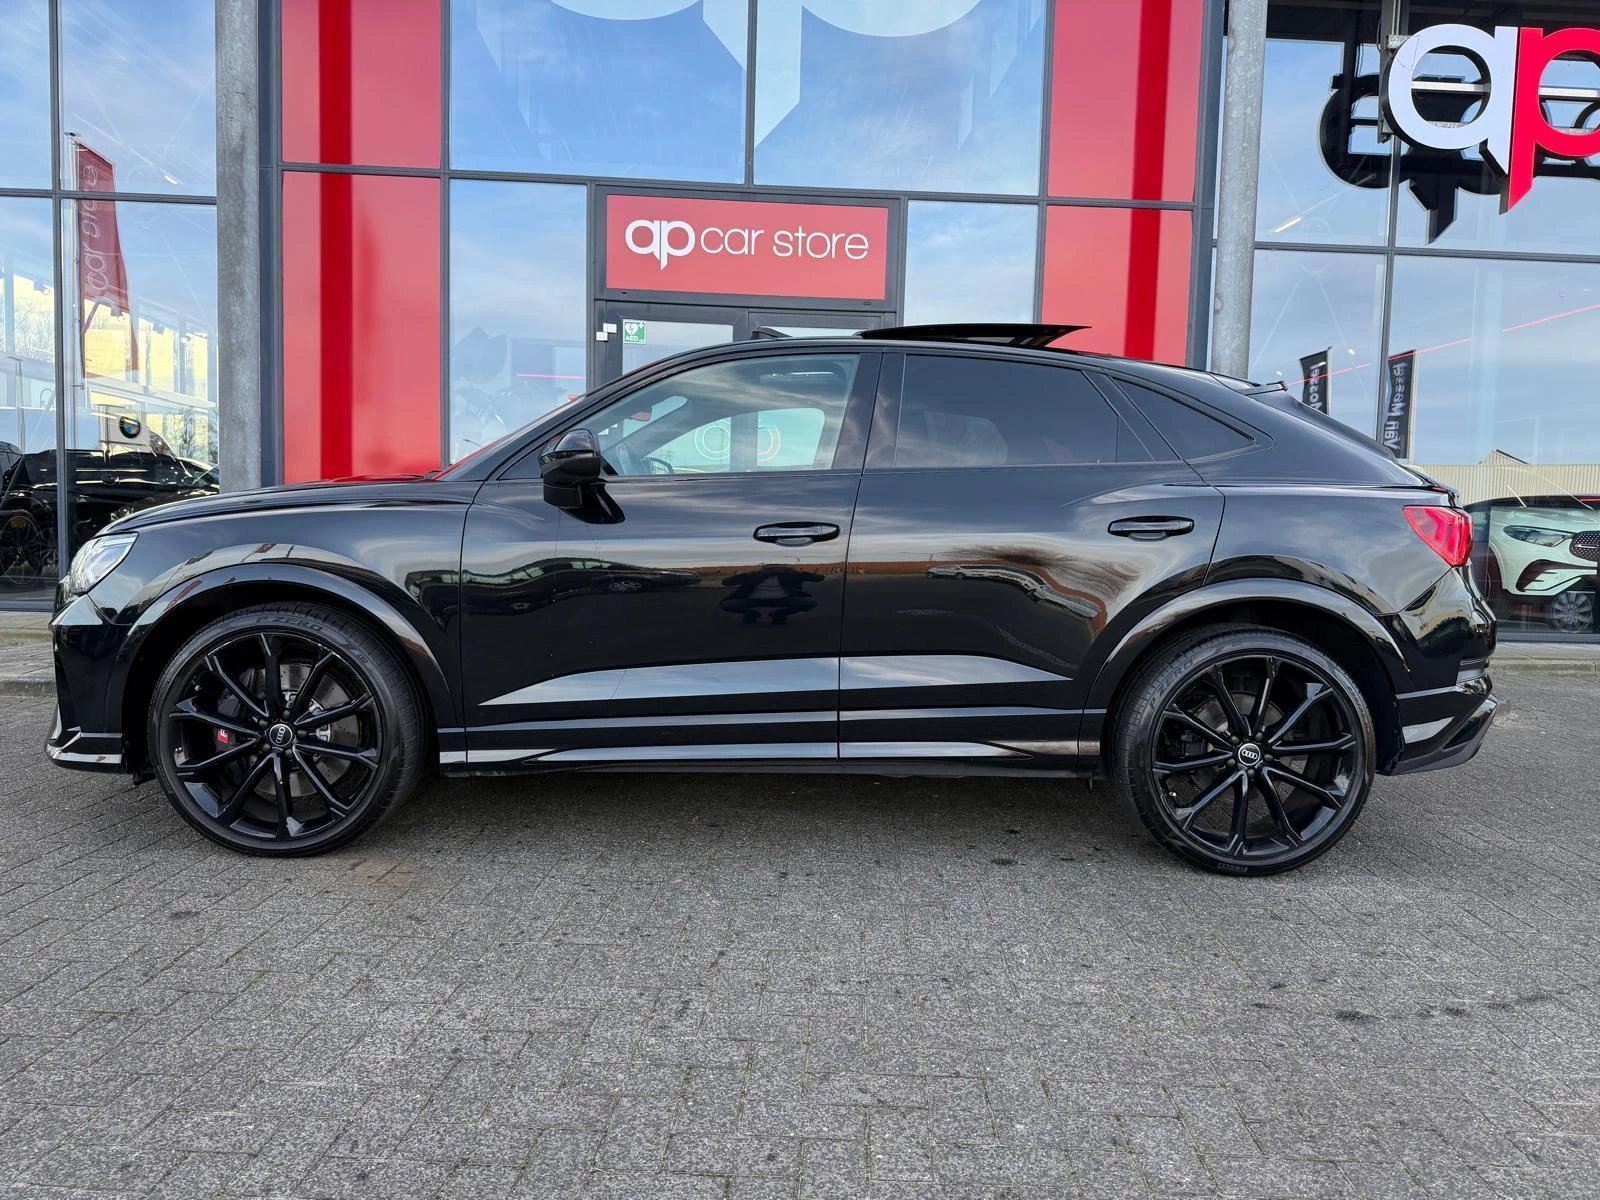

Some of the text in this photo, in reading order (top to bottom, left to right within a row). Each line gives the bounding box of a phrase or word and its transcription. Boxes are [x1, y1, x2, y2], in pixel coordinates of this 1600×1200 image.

[79, 165, 109, 291] car stoe
[700, 227, 765, 255] car
[773, 226, 869, 260] store
[272, 616, 324, 631] ZERO
[1149, 660, 1194, 710] P ZERO
